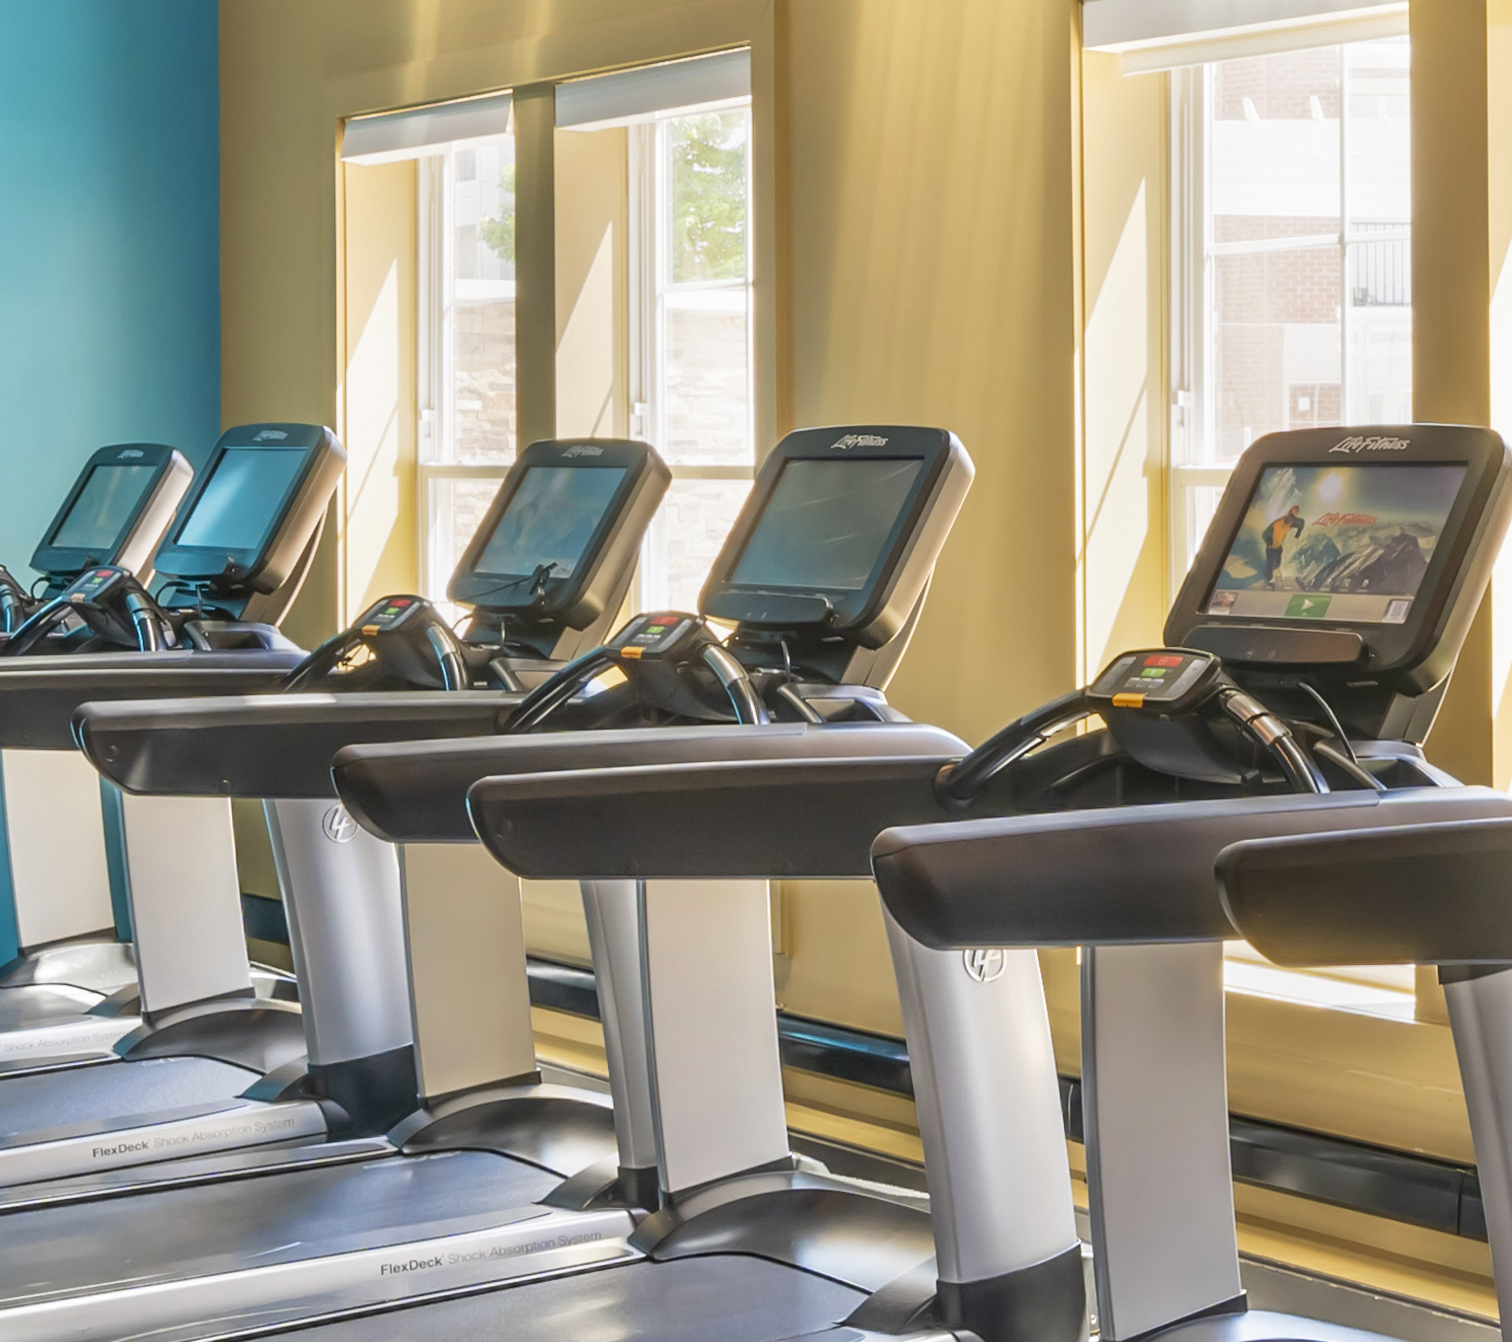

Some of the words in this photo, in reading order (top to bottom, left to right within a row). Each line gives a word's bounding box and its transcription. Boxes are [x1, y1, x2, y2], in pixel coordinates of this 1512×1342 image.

[92, 1141, 149, 1158] FlexDeck
[380, 1256, 444, 1276] FlexDeck
[448, 1249, 487, 1265] Shock
[489, 1238, 557, 1259] Absorption
